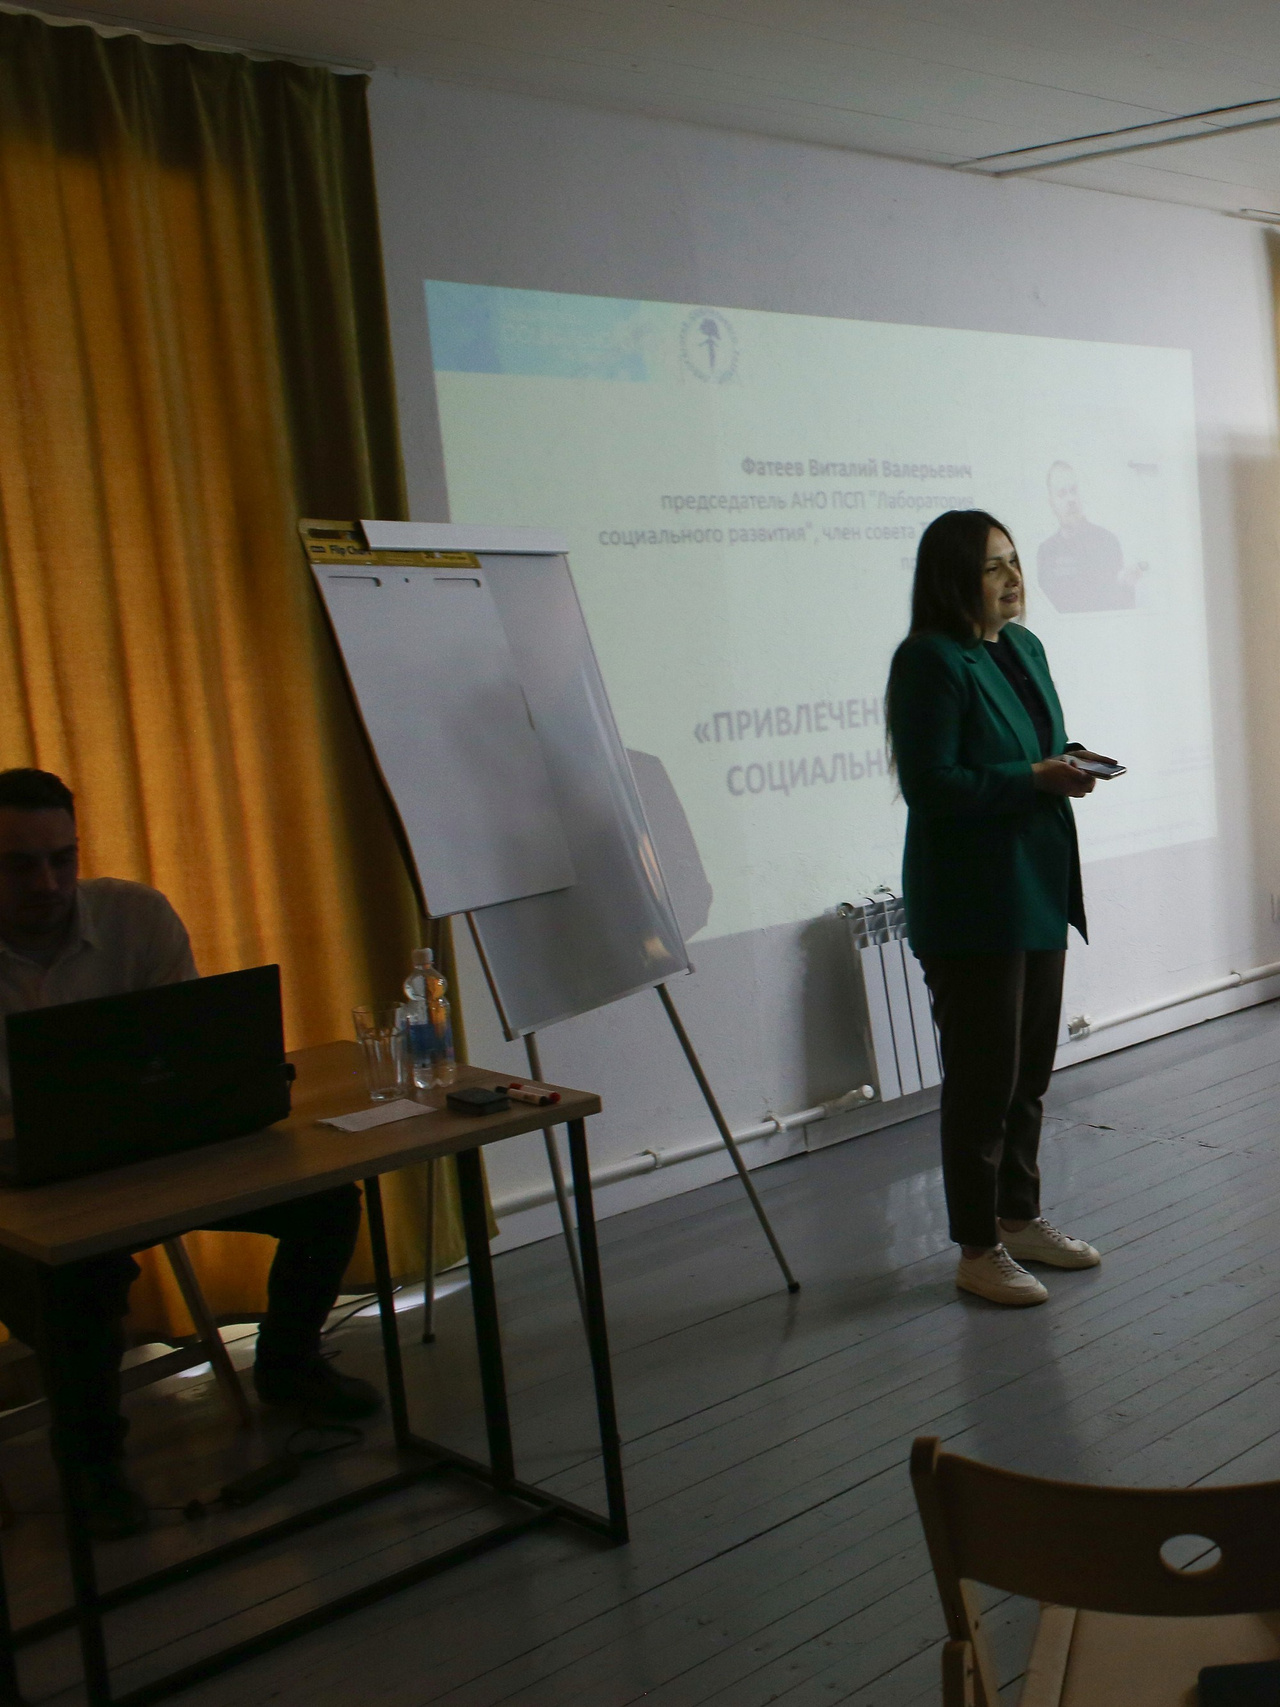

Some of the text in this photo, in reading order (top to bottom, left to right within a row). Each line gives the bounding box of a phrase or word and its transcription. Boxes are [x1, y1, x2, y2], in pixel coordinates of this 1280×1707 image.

[741, 456, 973, 481] Фатеев Виталий Валерьевич
[660, 493, 787, 513] председатель
[792, 490, 828, 509] АНО
[831, 491, 865, 509] ПСП
[599, 527, 724, 548] социального
[822, 526, 862, 542] член
[865, 525, 916, 540] совета
[727, 748, 887, 796] СОЦИАЛЬН
